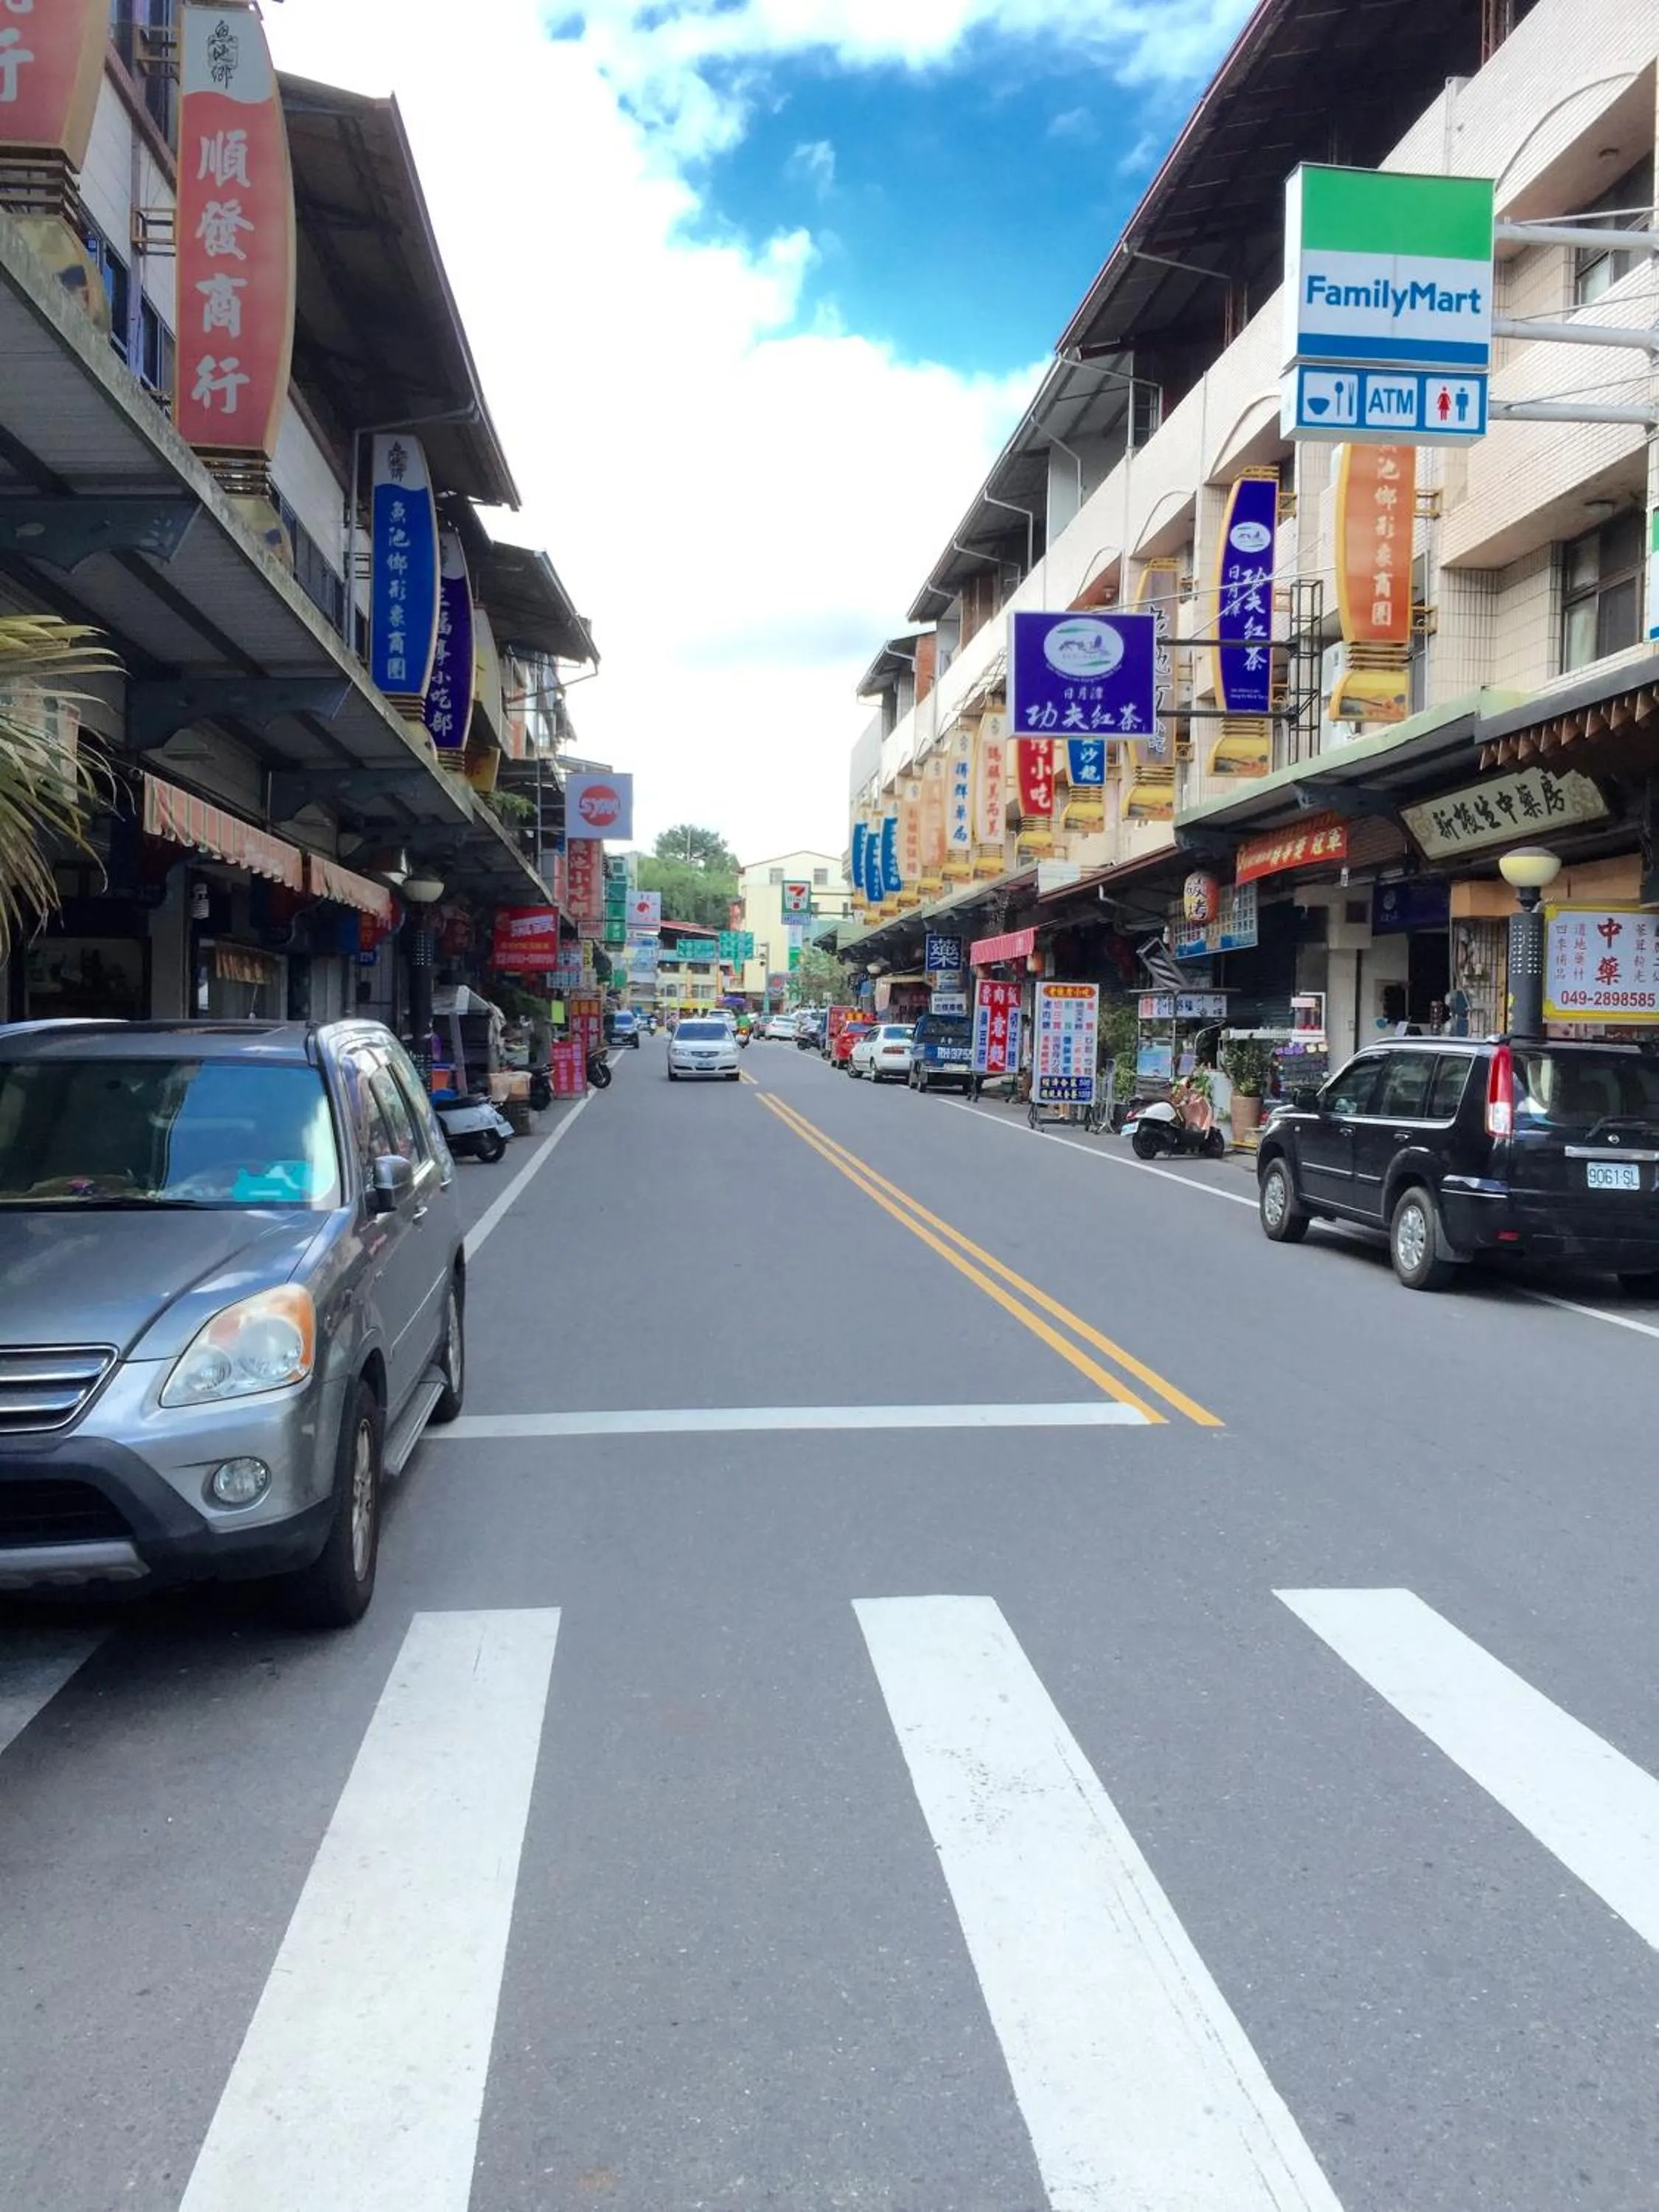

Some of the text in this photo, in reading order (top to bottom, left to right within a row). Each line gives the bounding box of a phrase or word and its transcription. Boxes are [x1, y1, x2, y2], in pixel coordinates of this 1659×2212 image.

[191, 130, 251, 414] 順發商行
[1306, 276, 1481, 317] FamilyMart
[1368, 387, 1414, 415] ATM
[1372, 445, 1400, 625] 池鄉形象商圈
[1242, 566, 1268, 671] 功夫紅茶
[1064, 686, 1104, 700] 日月潭
[1026, 701, 1142, 731] 功夫紅茶
[929, 938, 959, 968] 藥
[1595, 917, 1622, 986] 中藥
[1561, 990, 1656, 1007] 049-2898585
